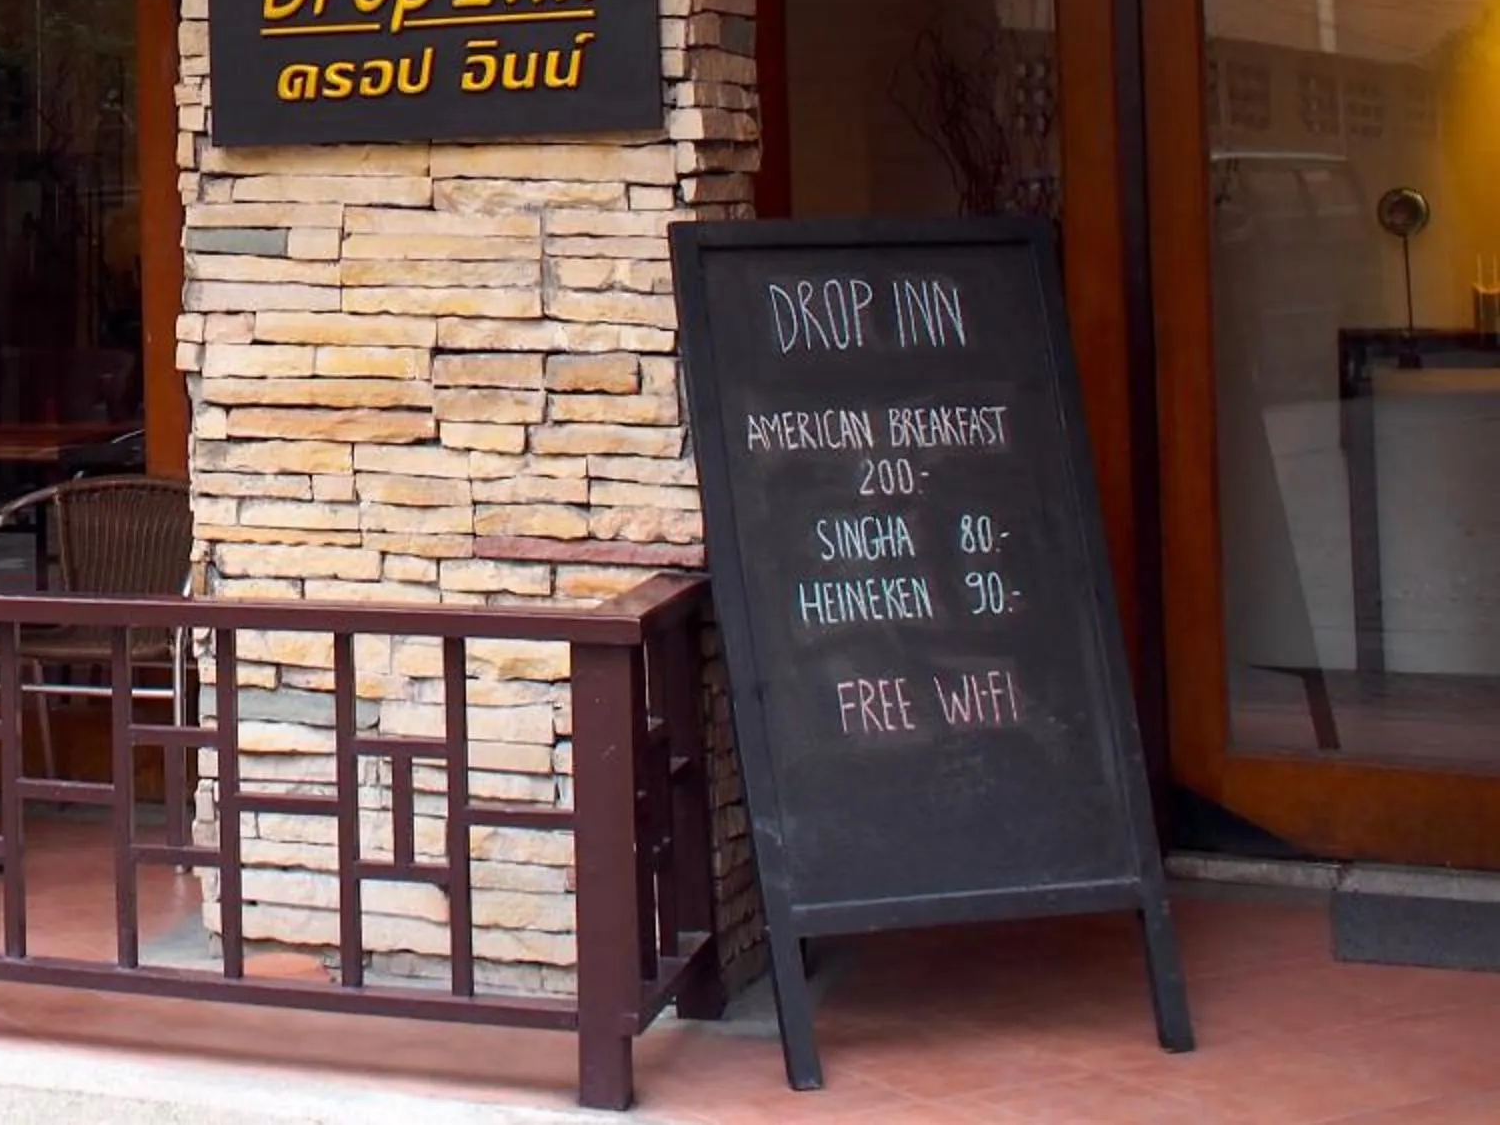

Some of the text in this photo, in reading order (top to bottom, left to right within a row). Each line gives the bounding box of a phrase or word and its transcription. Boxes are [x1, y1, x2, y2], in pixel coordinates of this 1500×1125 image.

[277, 32, 595, 101] ดรอป อินน์
[769, 279, 966, 353] DROP INN
[747, 406, 1007, 451] AMERICAN BREAKFAST
[815, 515, 916, 561] SINGHA
[799, 577, 933, 625] HEINEKEN
[836, 671, 1019, 734] FREE WI-FI
